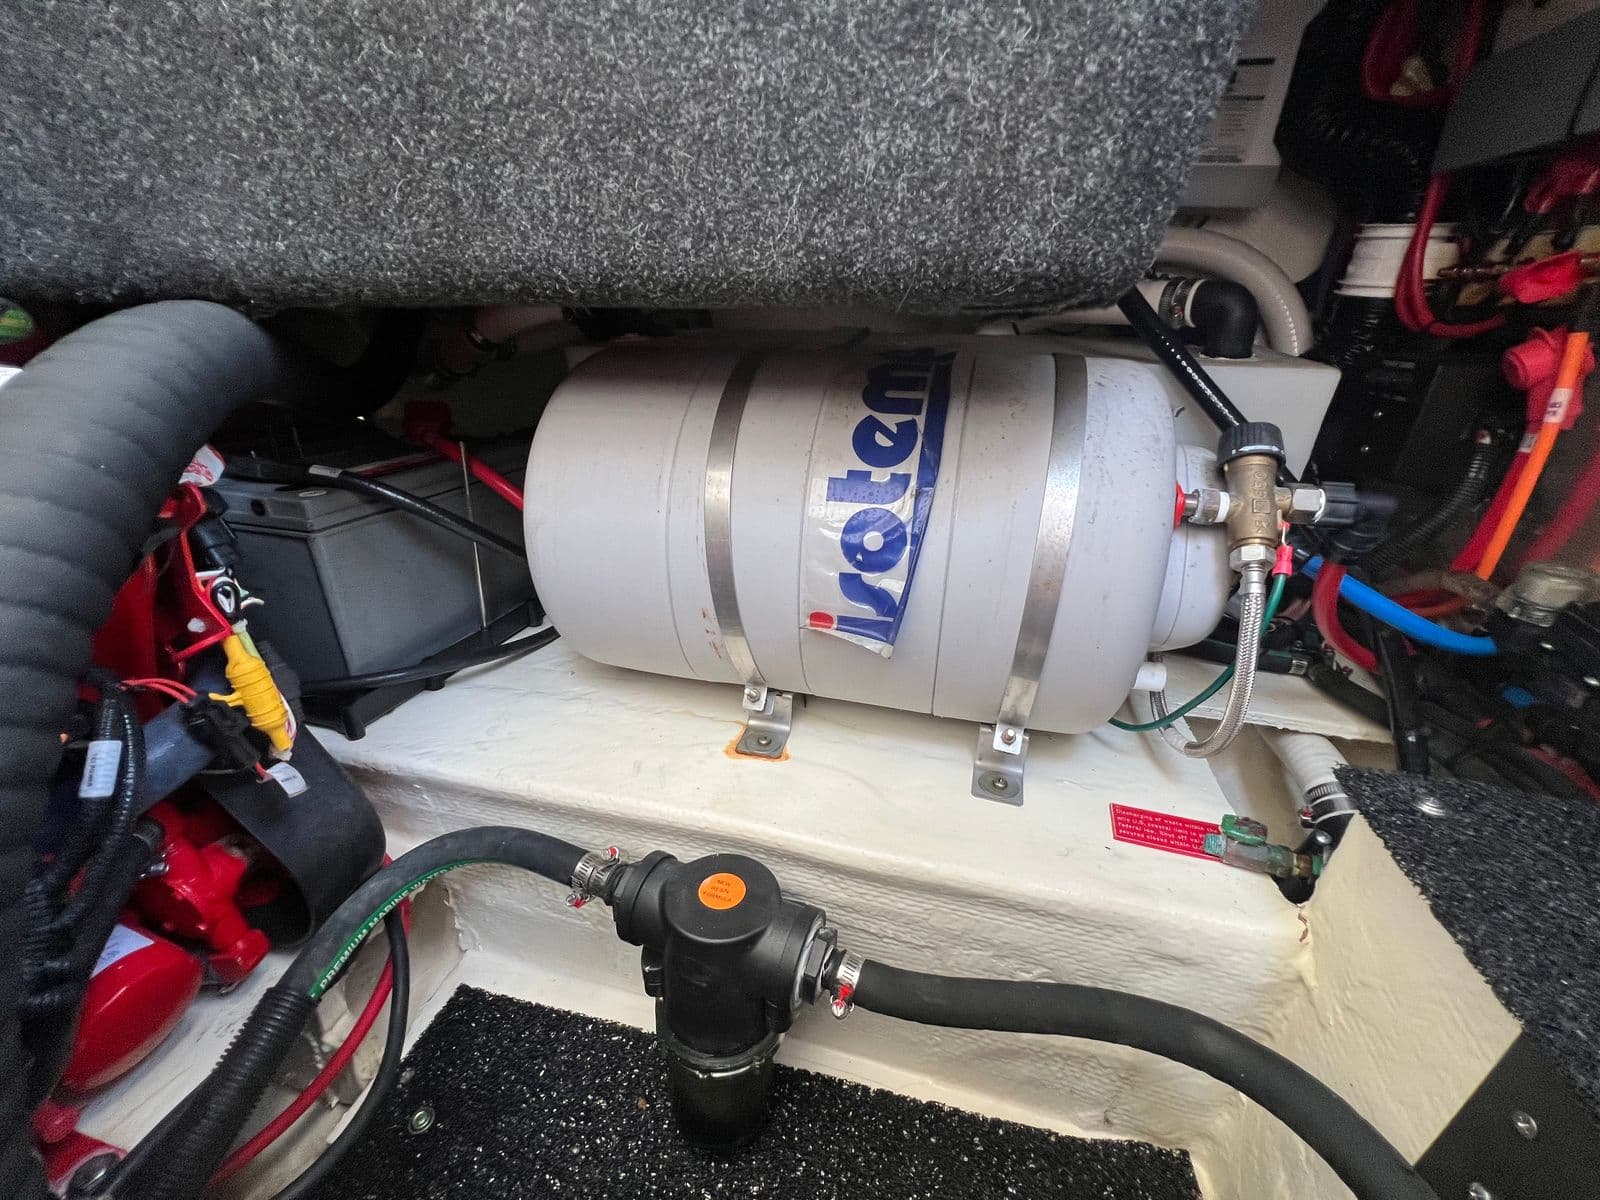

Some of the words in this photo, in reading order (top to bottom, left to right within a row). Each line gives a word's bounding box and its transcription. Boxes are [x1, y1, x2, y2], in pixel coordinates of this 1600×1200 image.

[1115, 808, 1153, 821] Discharging
[1184, 823, 1205, 831] within
[320, 929, 369, 990] PREMIUM
[369, 889, 410, 929] MARINE
